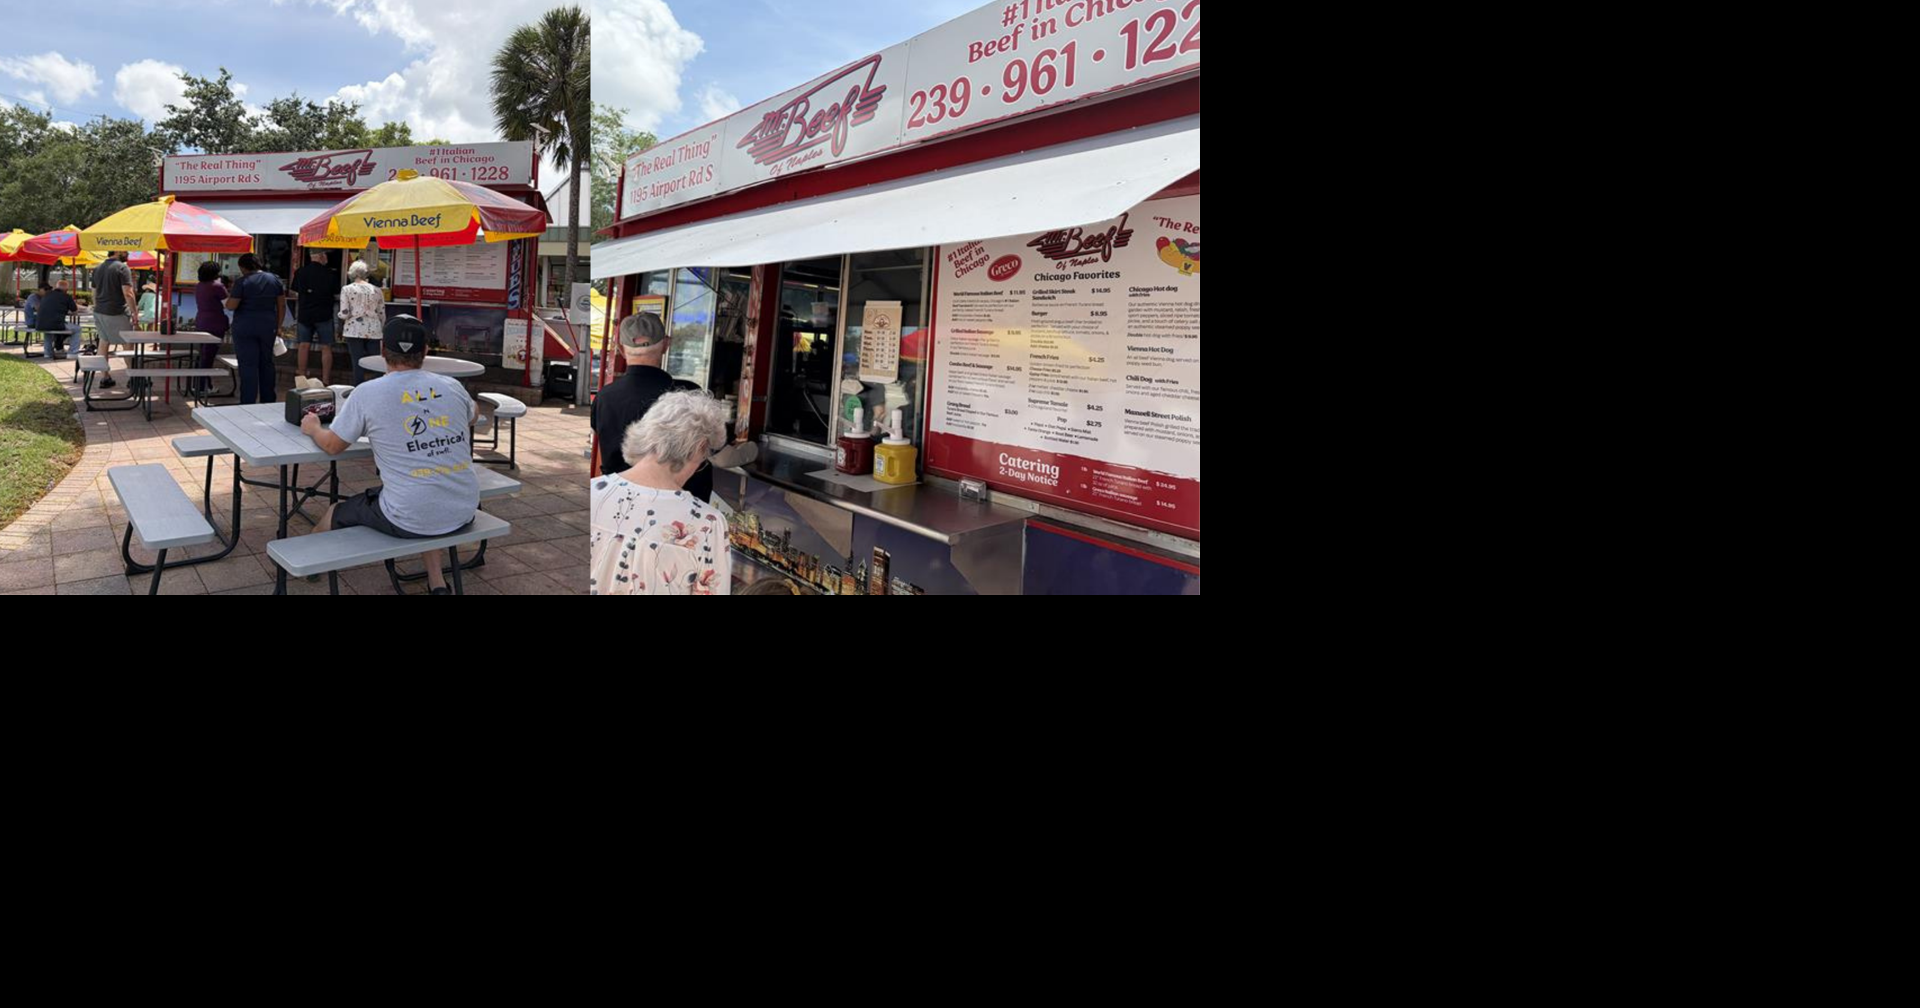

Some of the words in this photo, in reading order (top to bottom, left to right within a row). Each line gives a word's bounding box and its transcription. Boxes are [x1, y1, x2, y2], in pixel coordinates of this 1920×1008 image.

[968, 23, 1024, 63] Beef
[1031, 17, 1057, 41] in
[906, 76, 972, 130] 239
[1001, 40, 1077, 104] 961
[441, 147, 475, 156] Italian
[201, 160, 223, 170] Real
[415, 156, 438, 165] Beef
[440, 155, 451, 164] in
[453, 155, 495, 165] Chicago
[653, 149, 676, 173] Real
[770, 161, 783, 176] Of
[786, 148, 824, 171] Naples
[174, 175, 196, 184] 1195
[198, 174, 235, 186] Airport
[237, 173, 250, 184] Rd
[253, 174, 261, 183] S
[471, 165, 509, 181] 1228
[630, 188, 648, 205] 1195
[650, 176, 687, 199] Airport
[689, 166, 703, 187] Rd
[705, 164, 714, 182] S
[364, 217, 409, 229] Vienna
[411, 213, 442, 228] Beef
[96, 237, 122, 246] Vienna
[124, 236, 143, 248] Beef
[953, 249, 974, 270] Beef
[975, 245, 986, 257] in
[1056, 261, 1067, 271] Of
[1069, 256, 1099, 269] Naples
[954, 254, 991, 279] Chicago
[1033, 271, 1072, 283] Chicago
[1073, 270, 1121, 281] Favorites
[1165, 285, 1178, 293] dog
[1160, 347, 1174, 355] Dog
[1140, 376, 1153, 384] Dog
[401, 387, 442, 404] ALL
[1086, 404, 1103, 412] $4.25
[1124, 408, 1151, 417] Maxwell
[1151, 411, 1171, 420] Street
[1171, 413, 1192, 422] Polish
[1057, 416, 1068, 424] Pop
[1086, 420, 1103, 428] $2.75
[406, 431, 465, 453] Electrical
[999, 452, 1060, 479] Catering
[999, 466, 1027, 482] 2-Day
[1027, 472, 1059, 487] Notice
